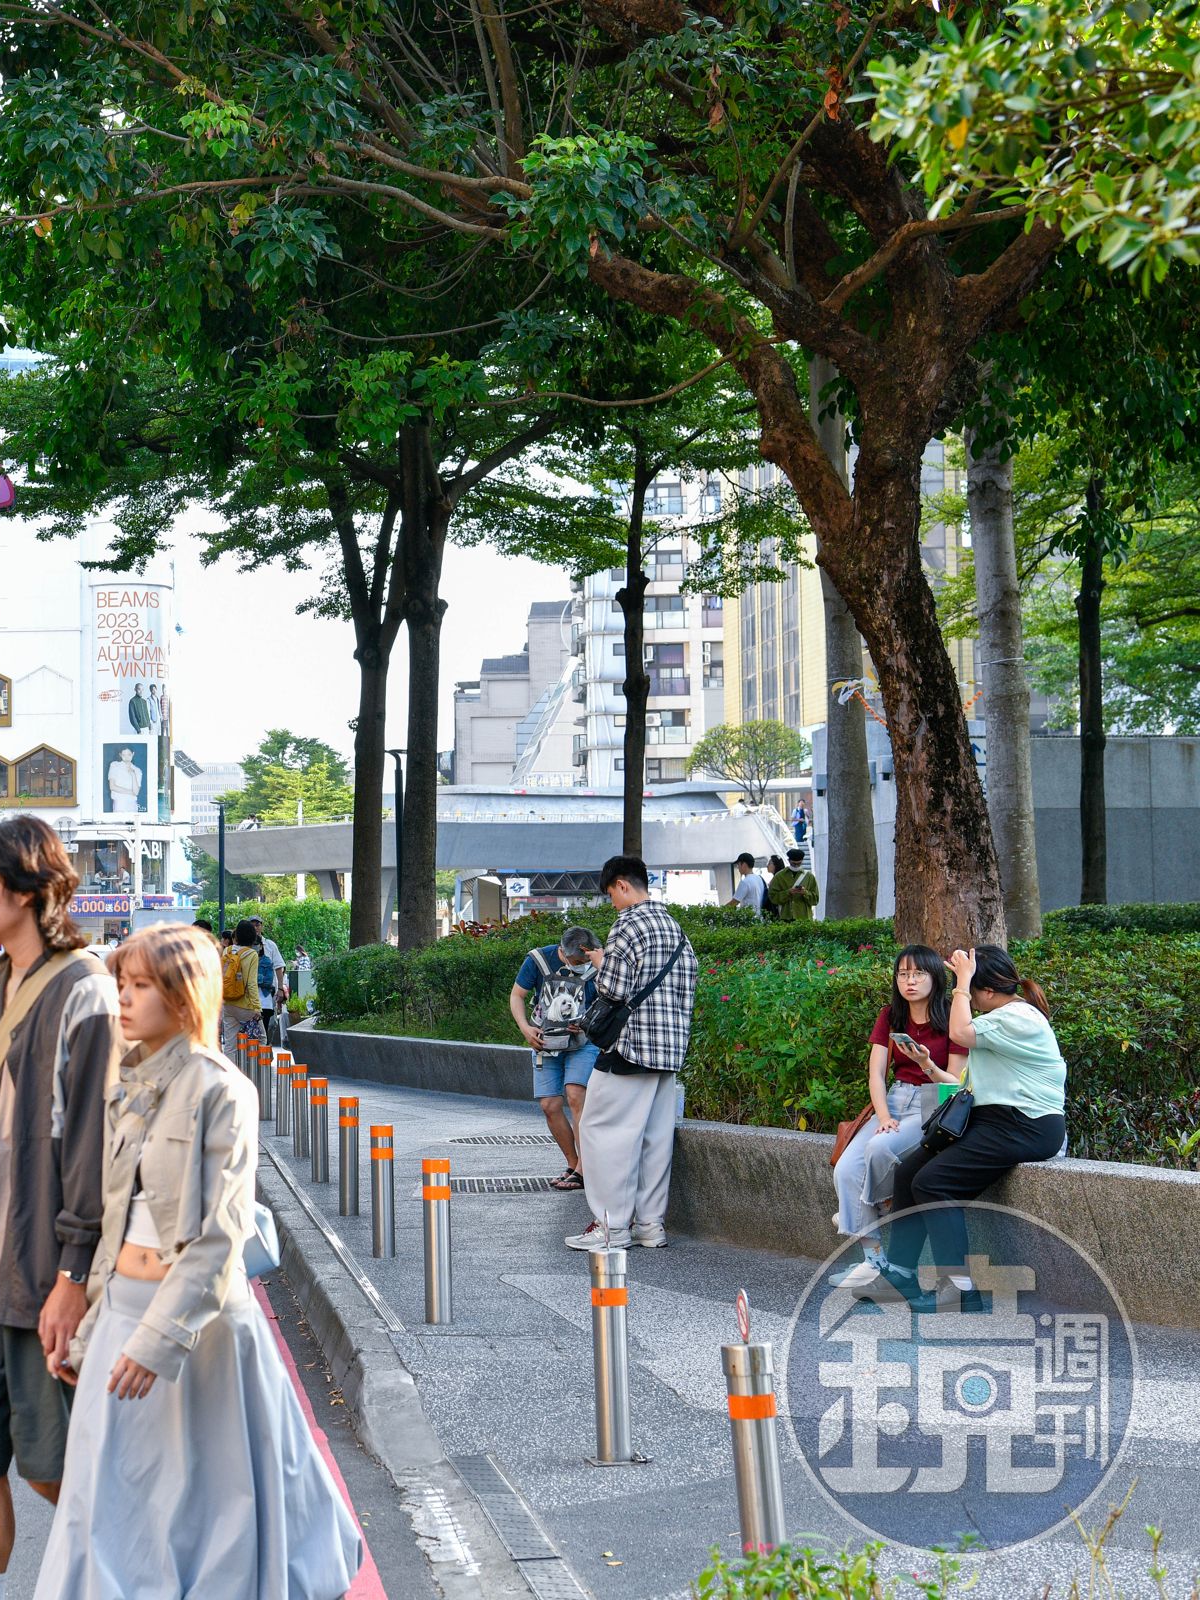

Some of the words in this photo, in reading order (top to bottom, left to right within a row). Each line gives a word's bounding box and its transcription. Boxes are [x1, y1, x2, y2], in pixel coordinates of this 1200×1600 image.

[97, 591, 160, 608] BEAMS
[97, 612, 139, 629] 2023
[97, 645, 166, 662] AUTUMN
